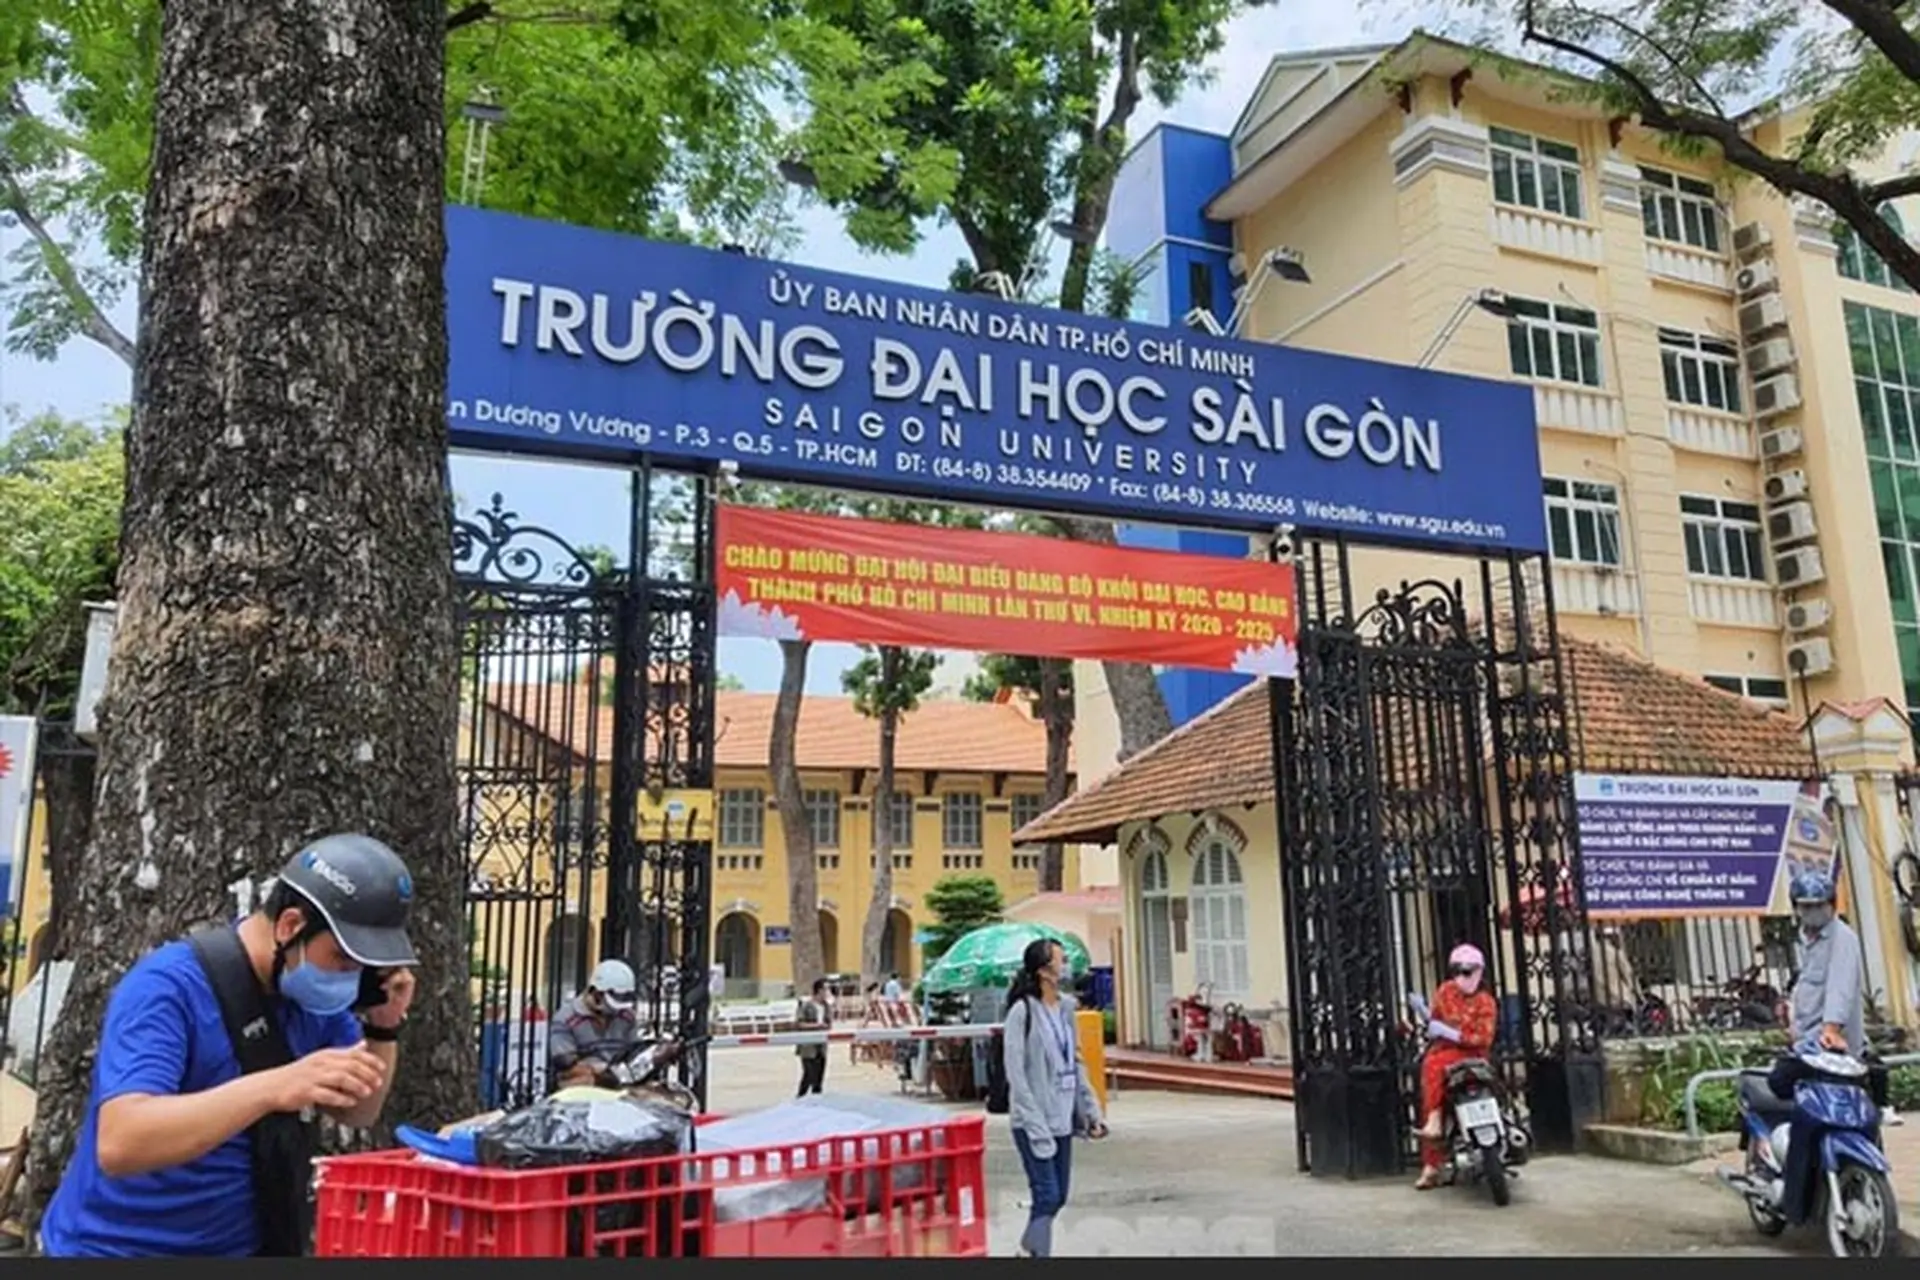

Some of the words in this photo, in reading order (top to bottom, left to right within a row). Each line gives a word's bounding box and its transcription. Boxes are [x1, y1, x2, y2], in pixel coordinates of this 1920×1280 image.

[769, 268, 814, 306] ỦY
[825, 286, 886, 321] BAN
[897, 298, 979, 334] NHÂN
[988, 313, 1048, 346] DÂN
[1056, 325, 1130, 359] TP.HỒ
[1138, 337, 1183, 367] CHÍ
[1191, 348, 1254, 378] MINH
[493, 277, 844, 389] TRƯỜNG
[871, 337, 993, 417] ĐẠI
[1019, 359, 1168, 438] HỌC
[1191, 380, 1287, 451] SÀI
[1305, 397, 1442, 471] GÒN
[449, 401, 466, 418] n
[475, 400, 561, 433] Dương
[569, 411, 651, 443] Vương
[675, 424, 710, 447] P.3
[733, 432, 773, 455] Q.5
[795, 439, 876, 467] TP.HCM
[896, 452, 926, 472] ĐT:
[933, 456, 991, 483] (84-8)
[997, 464, 1091, 491] 38.354409
[1110, 478, 1148, 500] Fax:
[1153, 483, 1205, 508] (84-8)
[1302, 500, 1374, 524] Website:
[1377, 511, 1505, 539] www.sgu.edu.vn
[766, 398, 962, 448] SAIGON
[1001, 429, 1257, 484] UNIVERSITY
[725, 544, 783, 570] CHÀO
[1215, 590, 1245, 612] CAO
[942, 592, 990, 616] MINH
[1181, 614, 1222, 635] 2020
[1236, 619, 1275, 641] 2025
